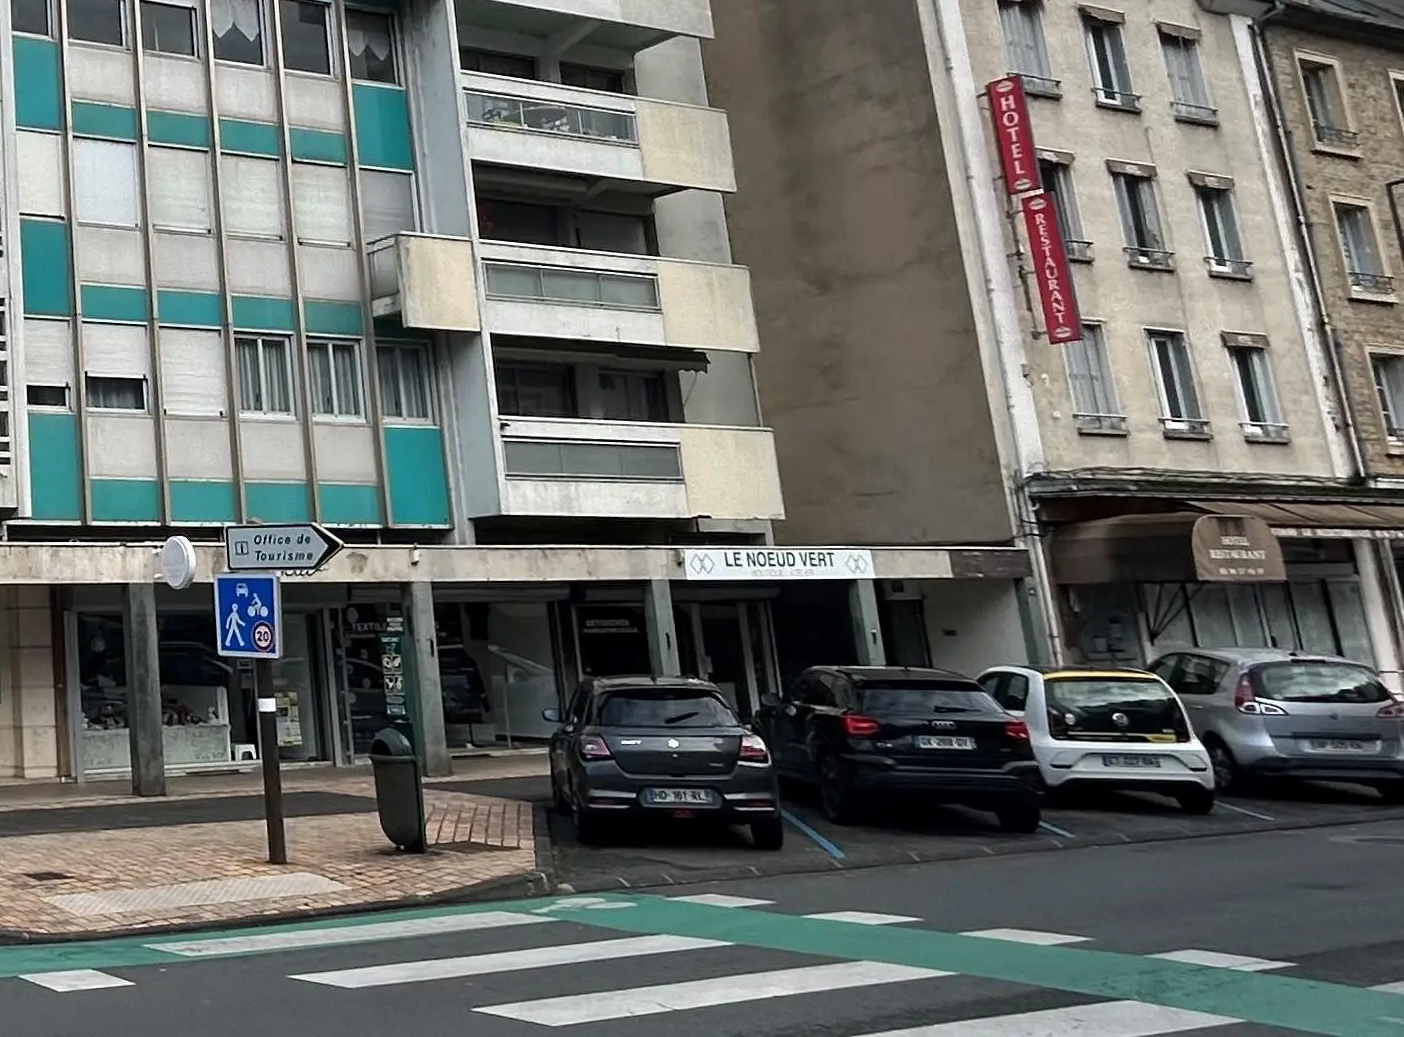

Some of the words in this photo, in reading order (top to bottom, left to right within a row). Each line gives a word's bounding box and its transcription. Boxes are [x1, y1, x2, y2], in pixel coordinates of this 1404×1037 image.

[1000, 94, 1025, 176] HOTEL
[1033, 212, 1066, 325] RESTAURANT
[253, 535, 291, 546] Office
[297, 534, 311, 545] de
[255, 550, 314, 562] Tourisme
[724, 551, 743, 567] LE
[747, 551, 795, 567] NOEUD
[799, 552, 834, 567] VERT
[257, 631, 269, 642] 20
